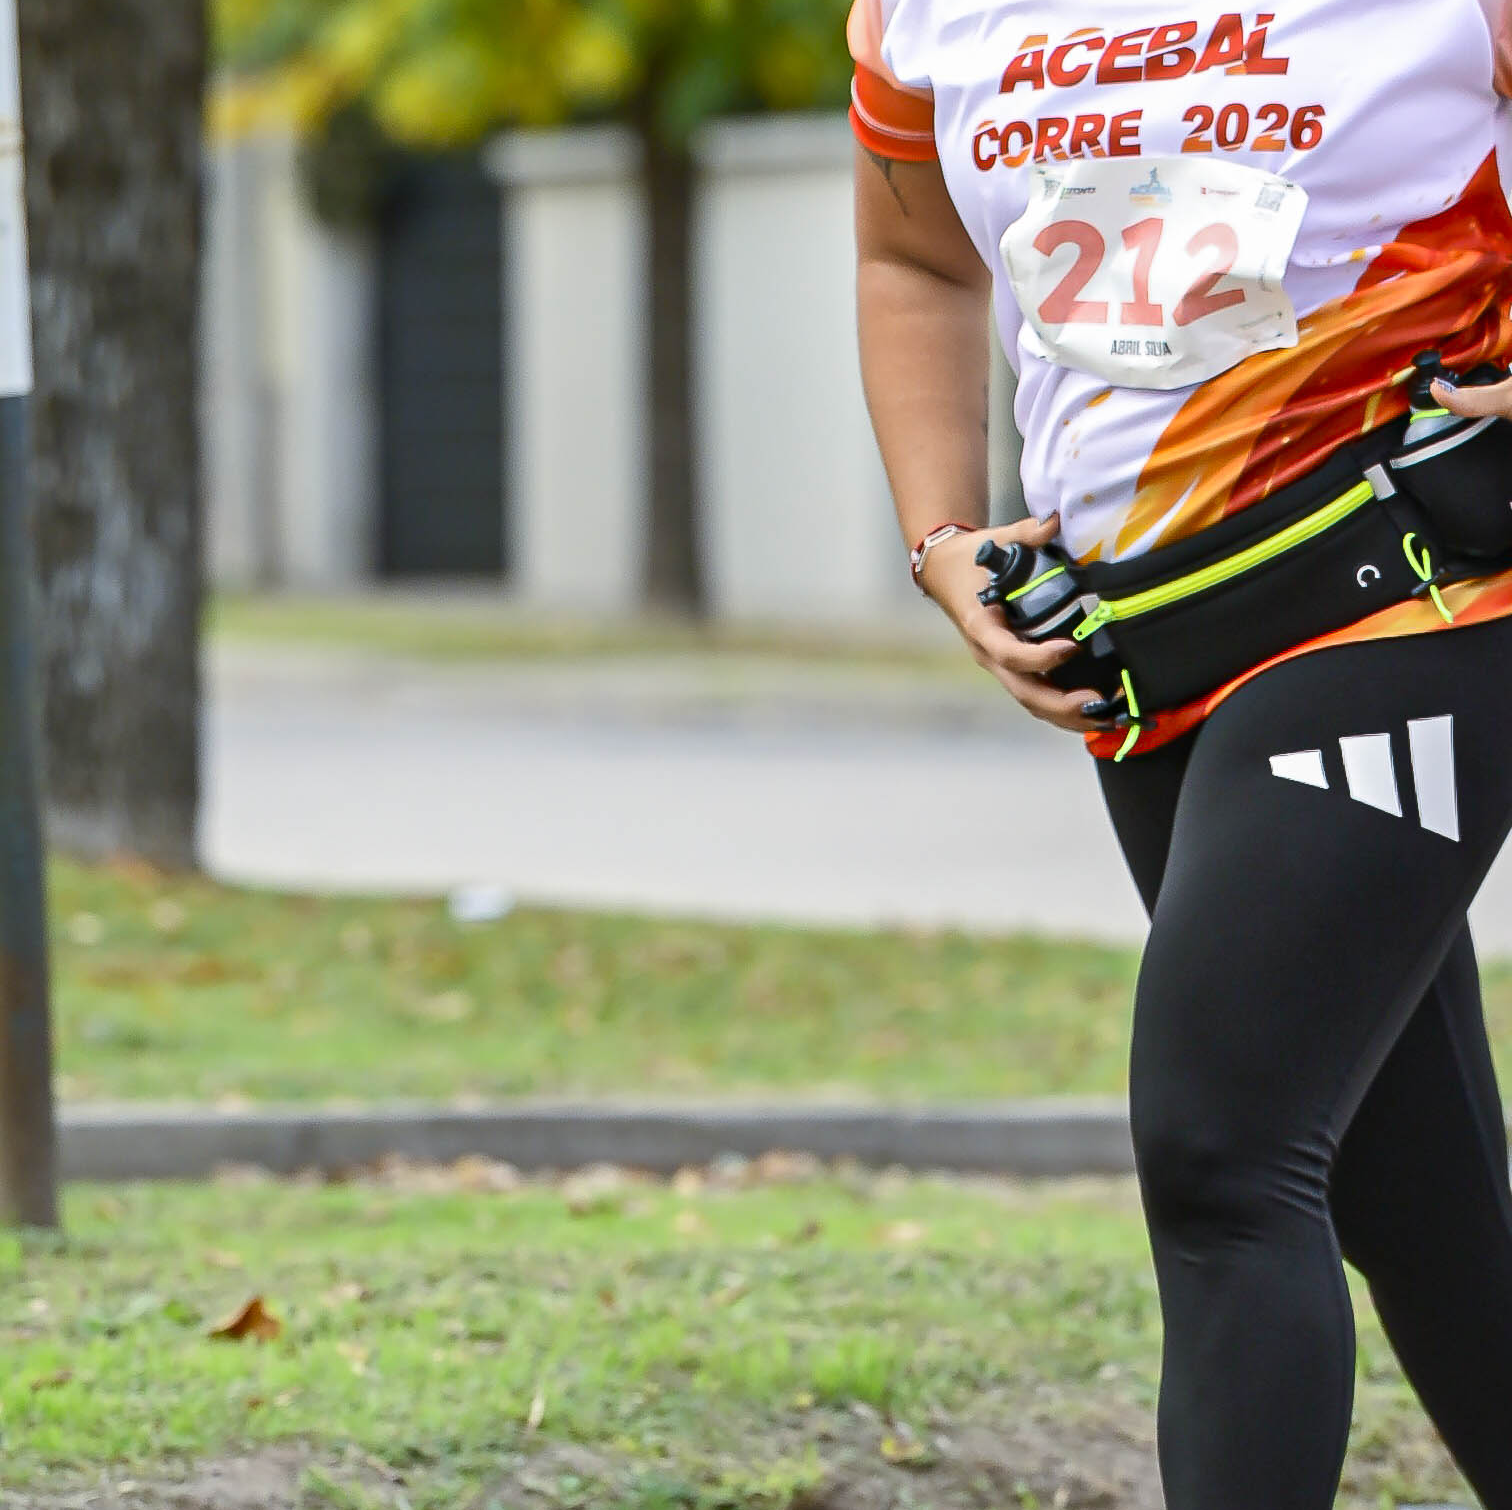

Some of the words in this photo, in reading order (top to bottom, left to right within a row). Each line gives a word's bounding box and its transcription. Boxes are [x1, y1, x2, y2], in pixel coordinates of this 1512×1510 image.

[1000, 12, 1291, 95] ACEBAL
[972, 108, 1144, 172] CORRE
[1180, 102, 1325, 154] 2026
[1031, 216, 1247, 328] 212
[1111, 339, 1141, 355] ABRIL
